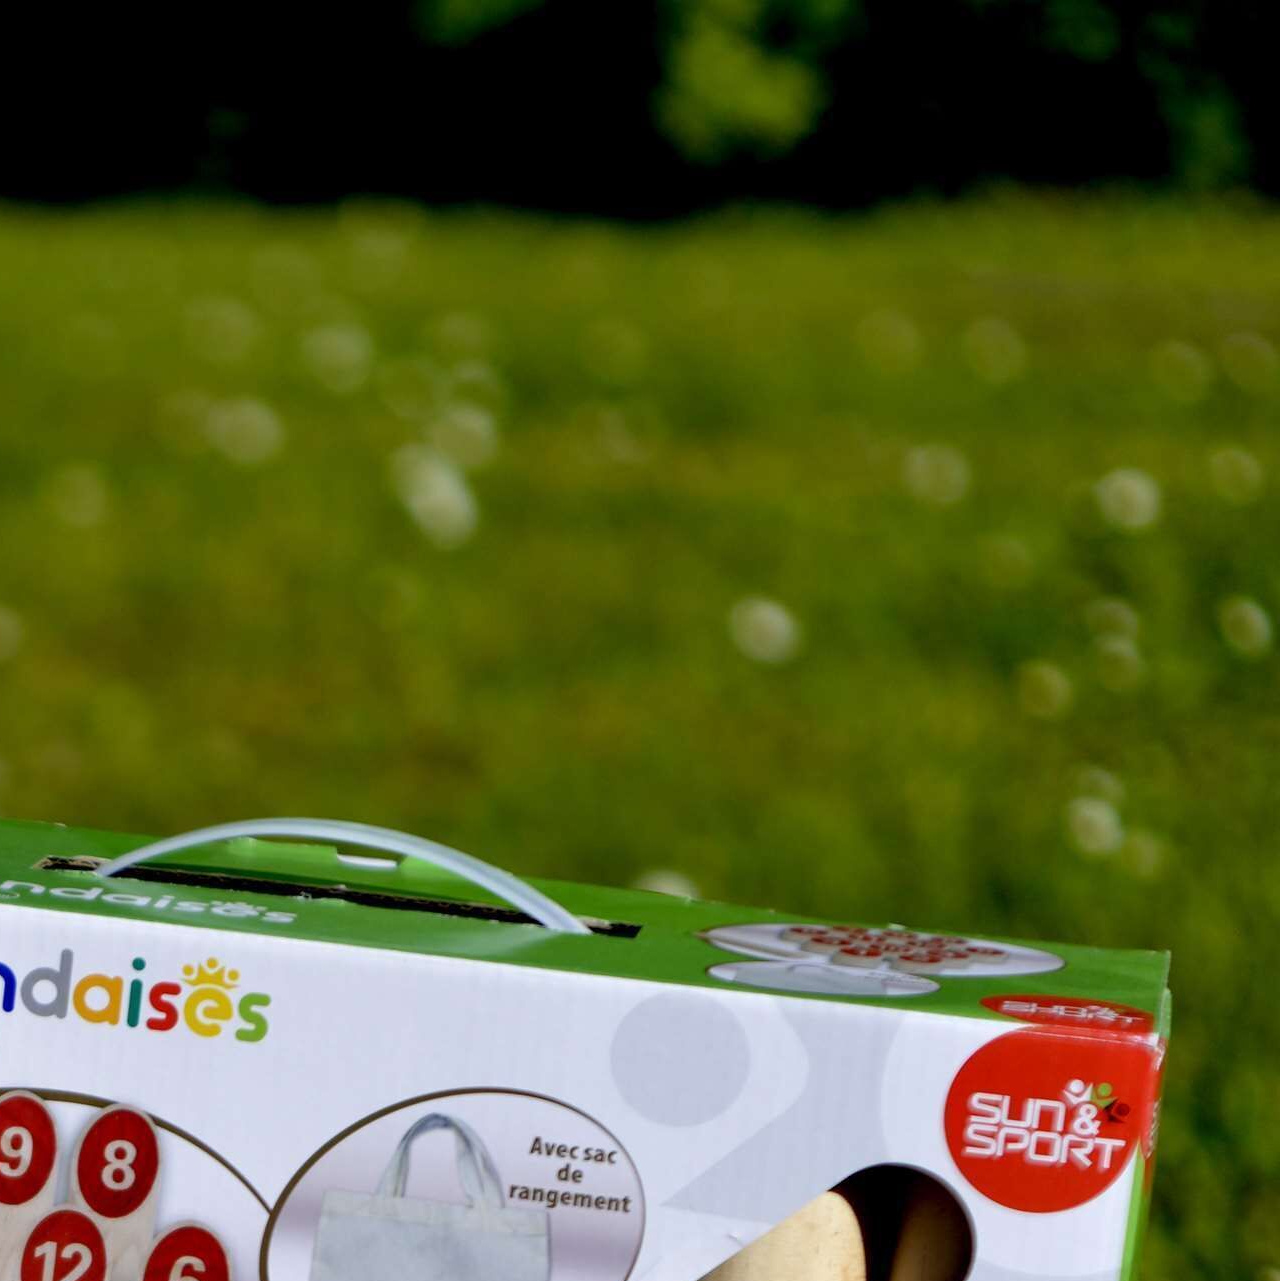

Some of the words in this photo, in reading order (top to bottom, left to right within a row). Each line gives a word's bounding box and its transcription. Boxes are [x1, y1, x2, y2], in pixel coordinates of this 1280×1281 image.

[968, 1091, 1066, 1133] SUN
[1073, 1103, 1102, 1136] &
[529, 1136, 580, 1160] Avec
[583, 1147, 618, 1165] sac
[963, 1123, 1127, 1170] SPORT
[100, 1139, 137, 1192] 8
[557, 1162, 584, 1183] de
[509, 1184, 632, 1214] rangement
